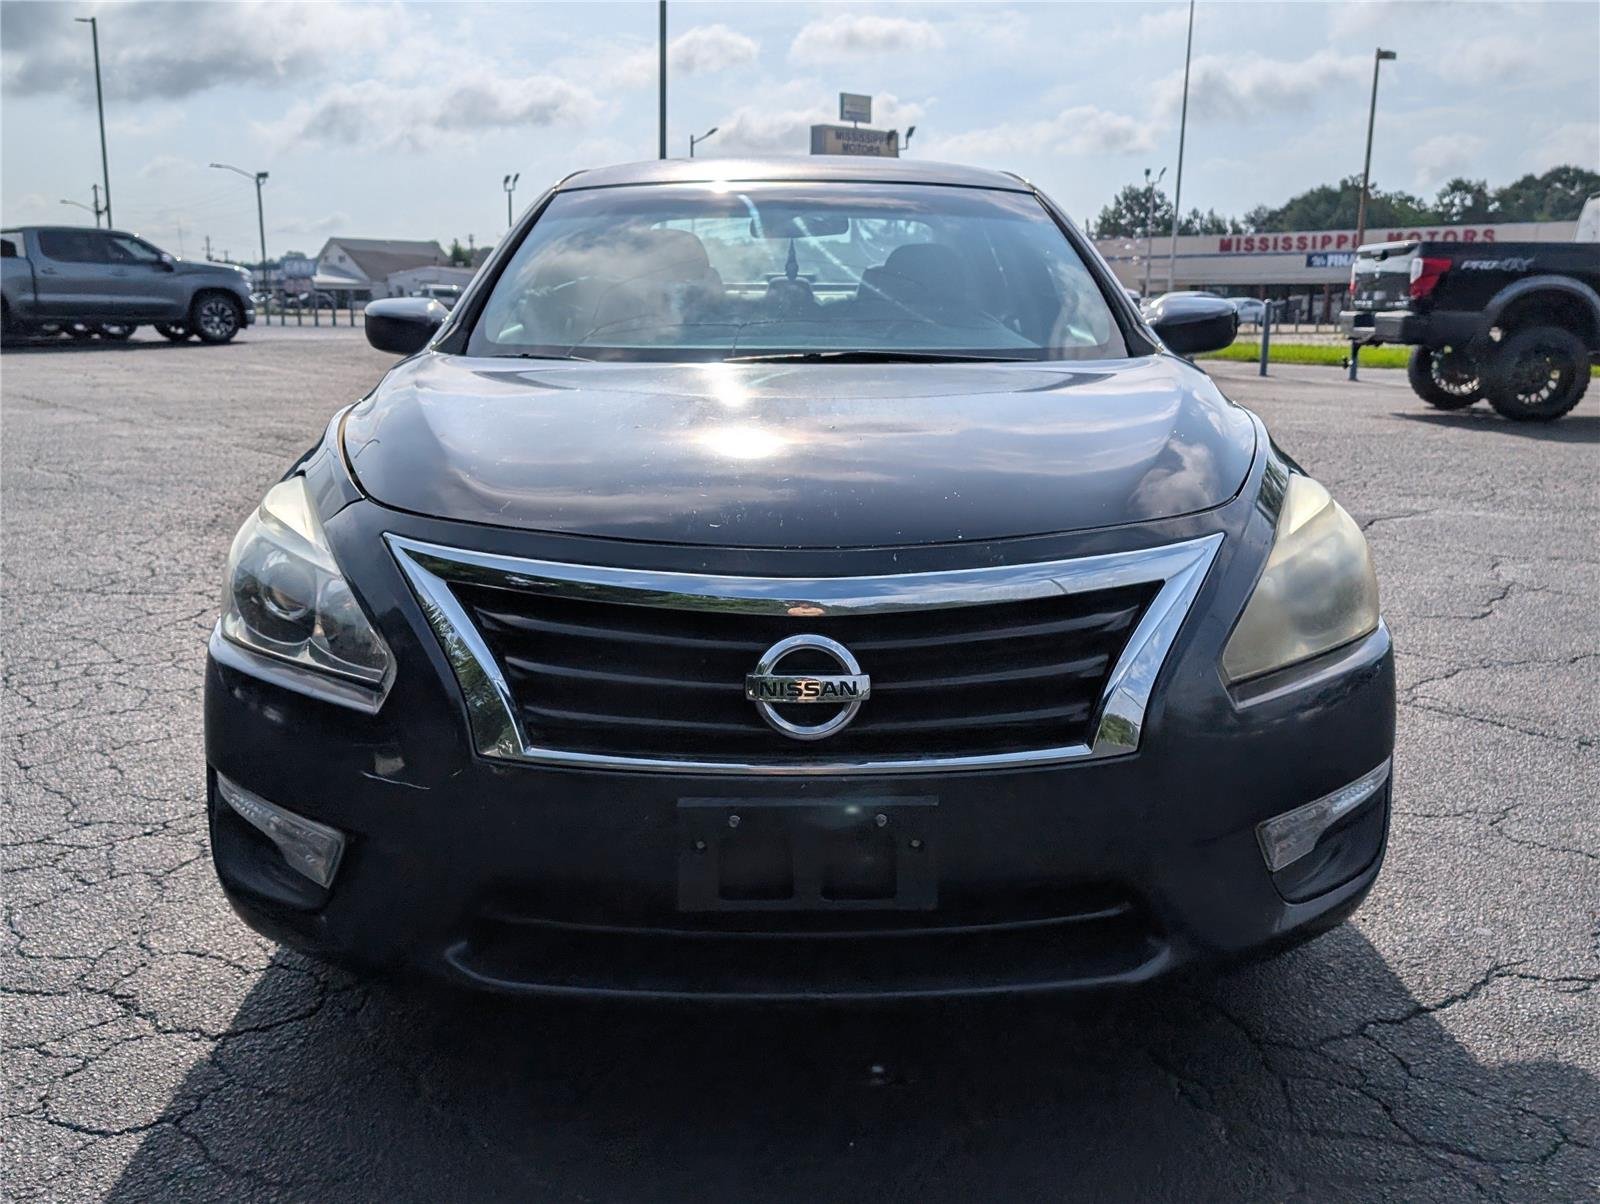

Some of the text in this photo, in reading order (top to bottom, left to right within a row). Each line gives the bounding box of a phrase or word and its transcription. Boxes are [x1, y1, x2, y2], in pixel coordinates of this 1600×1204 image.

[842, 142, 880, 154] MOTORS
[1219, 229, 1495, 252] MISSISSIPPI MOTORS
[760, 681, 857, 697] NISSAN
